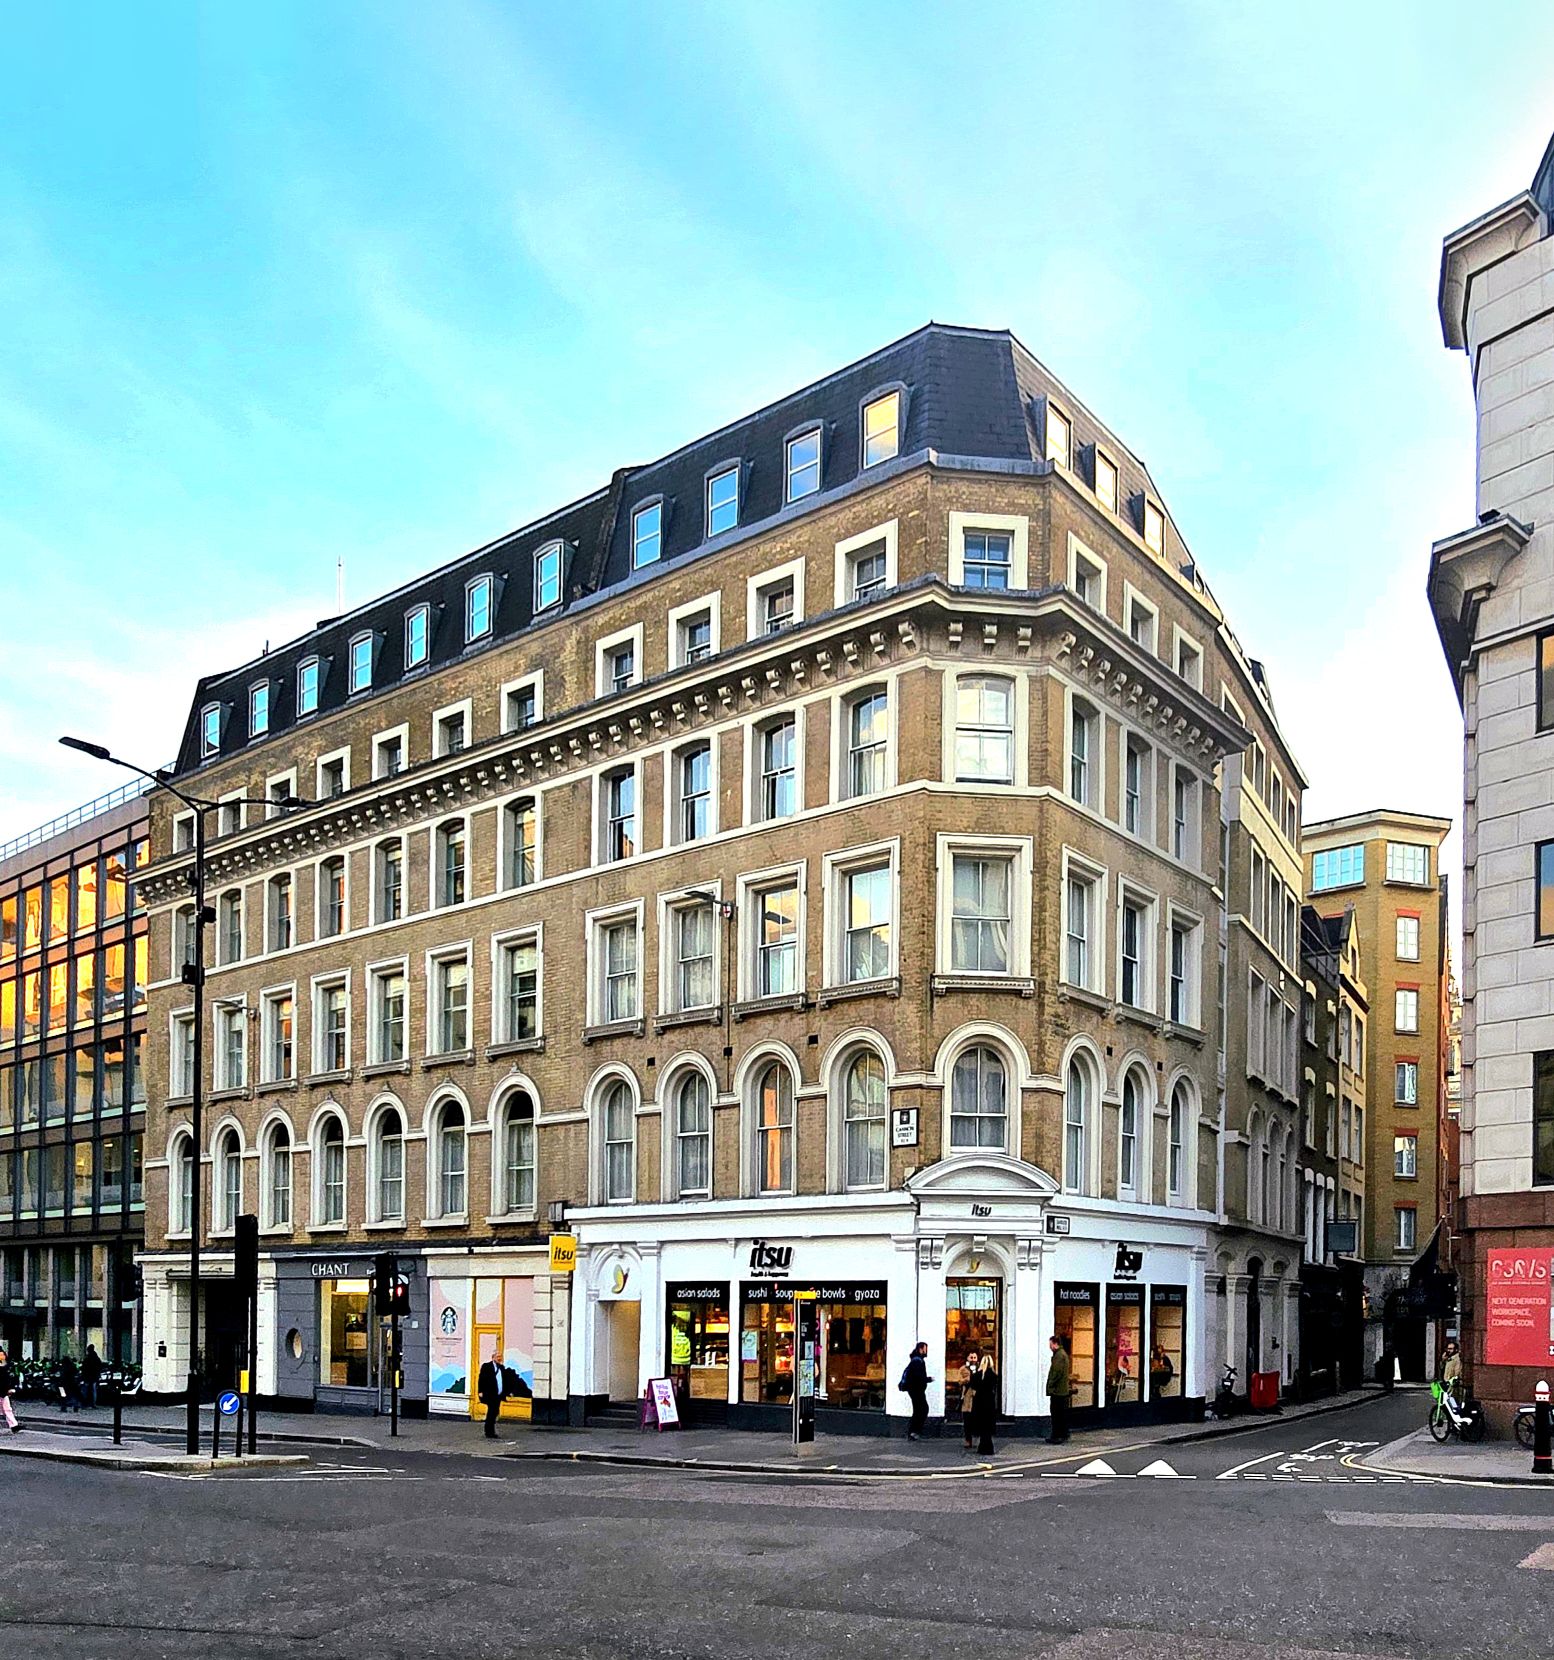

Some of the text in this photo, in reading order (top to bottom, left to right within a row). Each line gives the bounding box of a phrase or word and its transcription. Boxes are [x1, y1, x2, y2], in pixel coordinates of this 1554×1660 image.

[971, 1203, 992, 1216] itsu
[553, 1246, 574, 1260] itsu
[750, 1239, 792, 1268] itsu
[311, 1263, 350, 1276] CHANT
[677, 1287, 721, 1298] asian salads
[748, 1288, 768, 1298] sushi
[775, 1288, 797, 1300] soup
[822, 1287, 846, 1298] bowls
[855, 1288, 880, 1301] gyoza
[1060, 1288, 1091, 1300] hot noodles
